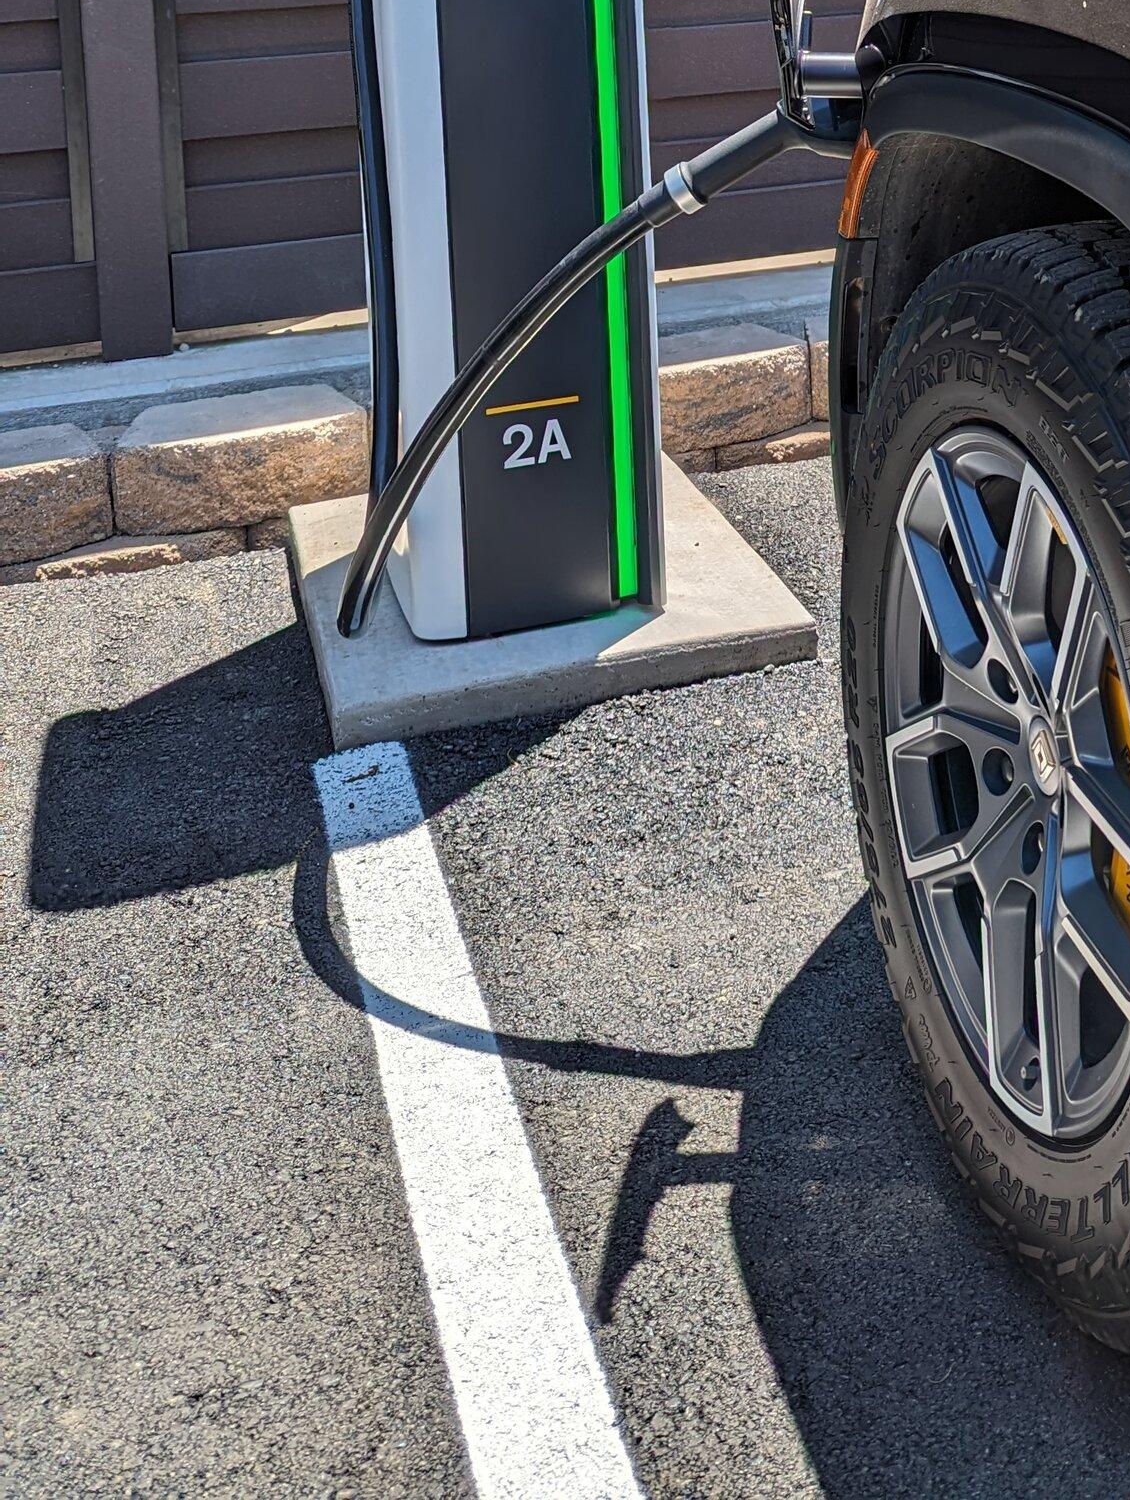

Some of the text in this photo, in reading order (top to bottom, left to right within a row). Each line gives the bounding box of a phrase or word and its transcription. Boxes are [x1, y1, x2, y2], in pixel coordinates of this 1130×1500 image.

[502, 418, 572, 470] 2A
[868, 348, 1022, 480] SCORPION
[935, 1077, 1095, 1244] TERRAIN
